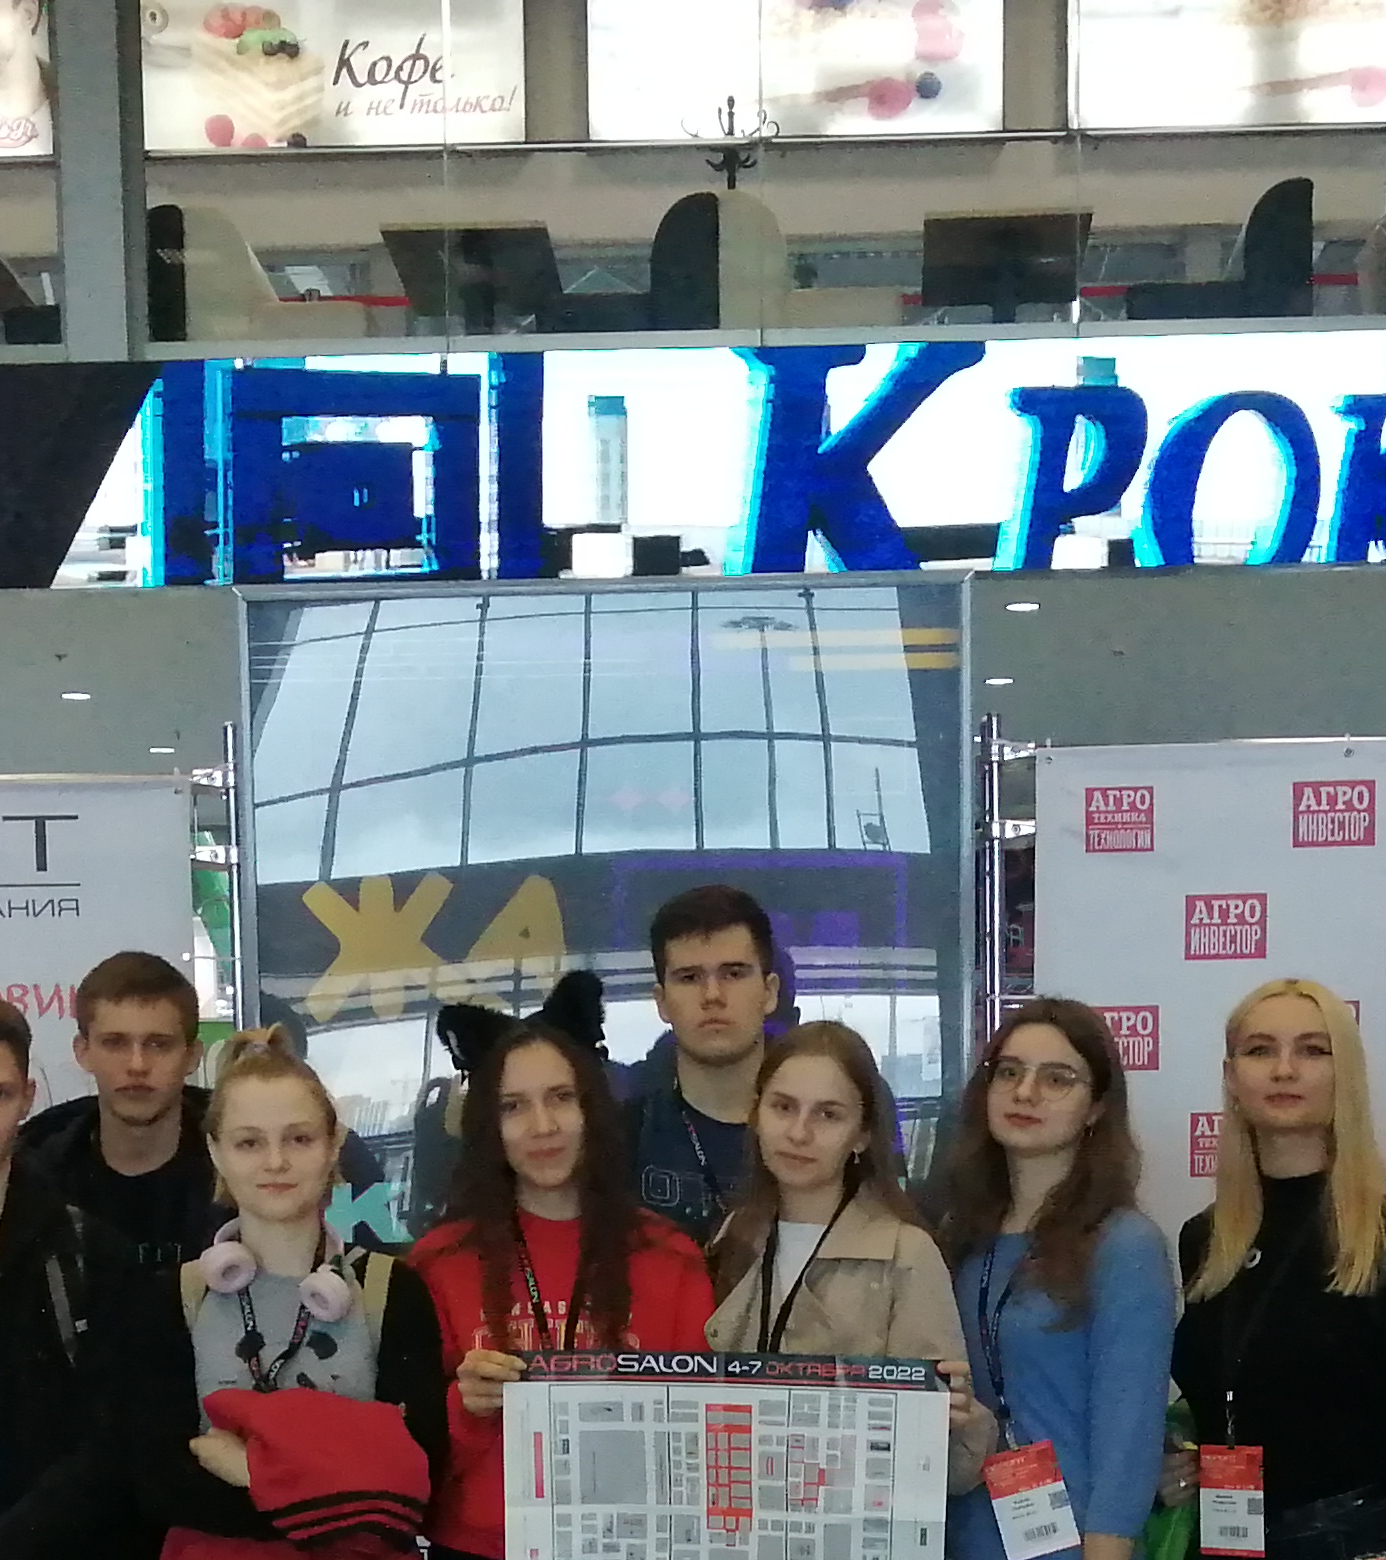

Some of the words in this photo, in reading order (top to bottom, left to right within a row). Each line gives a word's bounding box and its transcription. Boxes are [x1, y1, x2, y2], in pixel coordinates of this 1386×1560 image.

[332, 33, 454, 110] Кофе
[335, 100, 352, 117] и
[366, 98, 397, 116] не
[410, 86, 518, 116] только!
[1091, 790, 1149, 811] АГРО
[1299, 785, 1370, 811] АГРО
[1298, 812, 1368, 844] ИНВЕСТОР
[1191, 898, 1261, 924] АГРО
[1190, 925, 1260, 957] ИНВЕСТОР
[1104, 1010, 1154, 1035] ГРО
[529, 1353, 717, 1375] AGROSALON
[727, 1360, 762, 1376] 4-7
[868, 1366, 926, 1382] 2022
